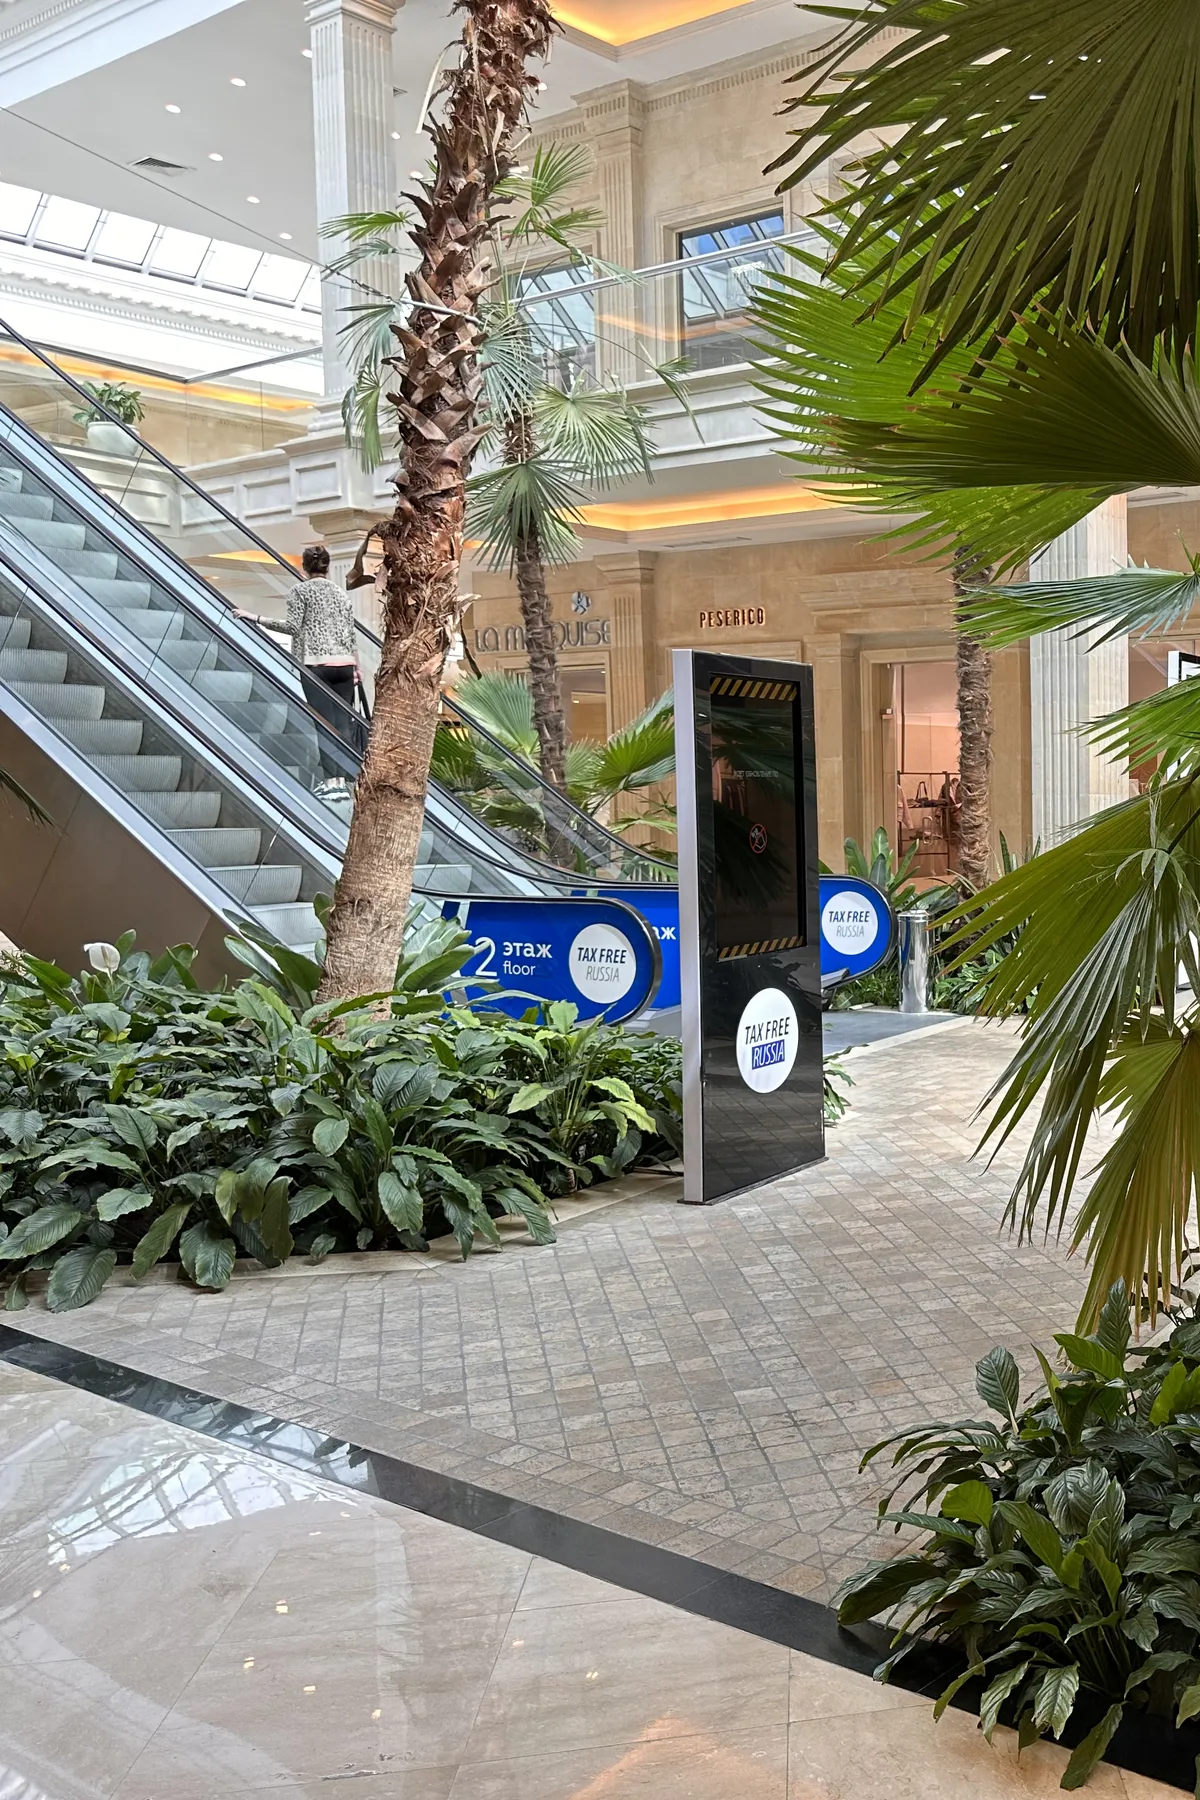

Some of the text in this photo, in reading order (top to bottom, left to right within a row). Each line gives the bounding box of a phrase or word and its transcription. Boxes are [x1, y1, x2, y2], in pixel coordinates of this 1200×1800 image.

[699, 607, 765, 629] PESERICO
[505, 618, 611, 651] MQUISE
[828, 910, 870, 923] TAX FREE
[836, 925, 865, 938] RUSSIA
[474, 936, 498, 977] 2
[502, 941, 553, 959] этаж
[577, 947, 627, 964] TAX FREE
[502, 961, 536, 976] floor
[585, 965, 620, 982] RUSSIA
[745, 1016, 790, 1045] TAX FREE
[753, 1041, 784, 1068] RUSSIA
